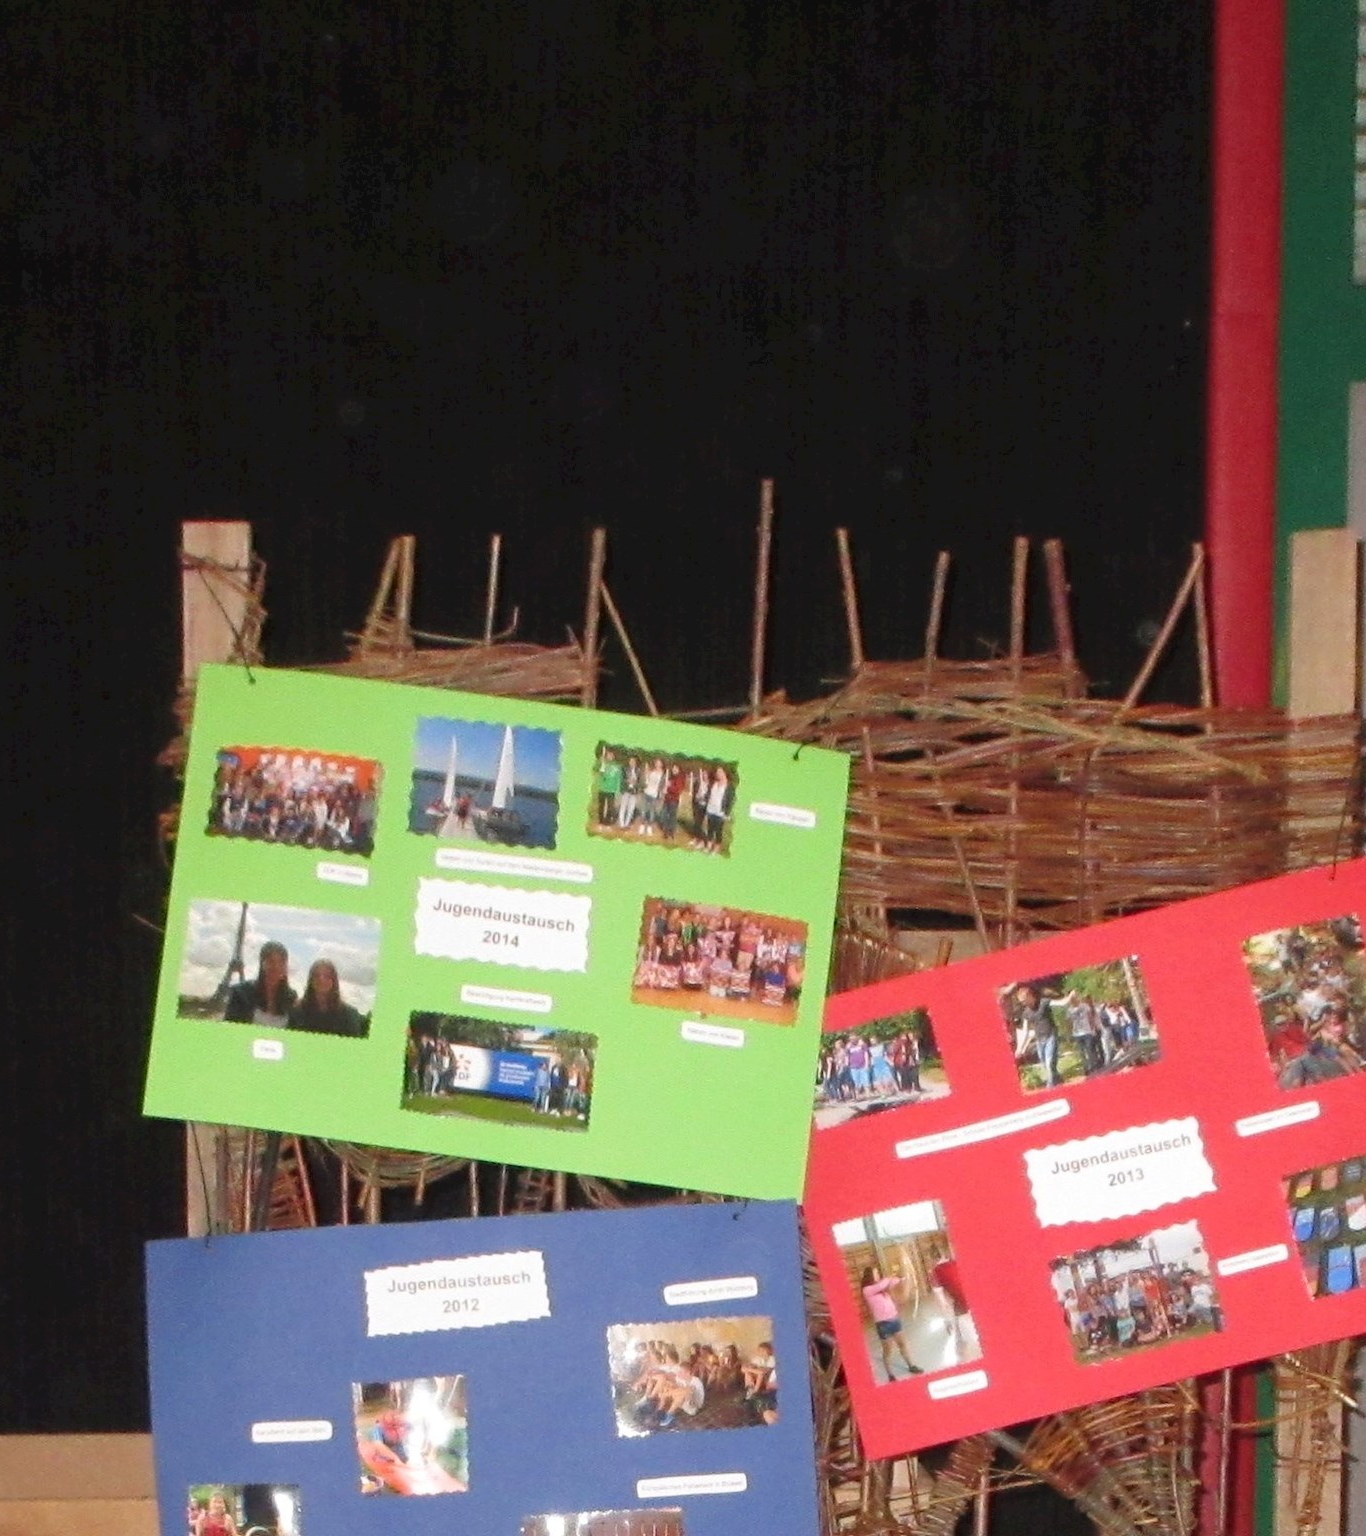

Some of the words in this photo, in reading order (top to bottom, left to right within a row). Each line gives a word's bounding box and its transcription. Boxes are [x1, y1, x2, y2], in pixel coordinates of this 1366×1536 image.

[433, 898, 575, 932] Jugendaustausch
[483, 930, 520, 948] 2014
[1051, 1133, 1192, 1174] Jugendaustausch
[1107, 1168, 1145, 1187] 2013
[388, 1271, 531, 1295] Jugendaustausch
[442, 1298, 480, 1313] 2012
